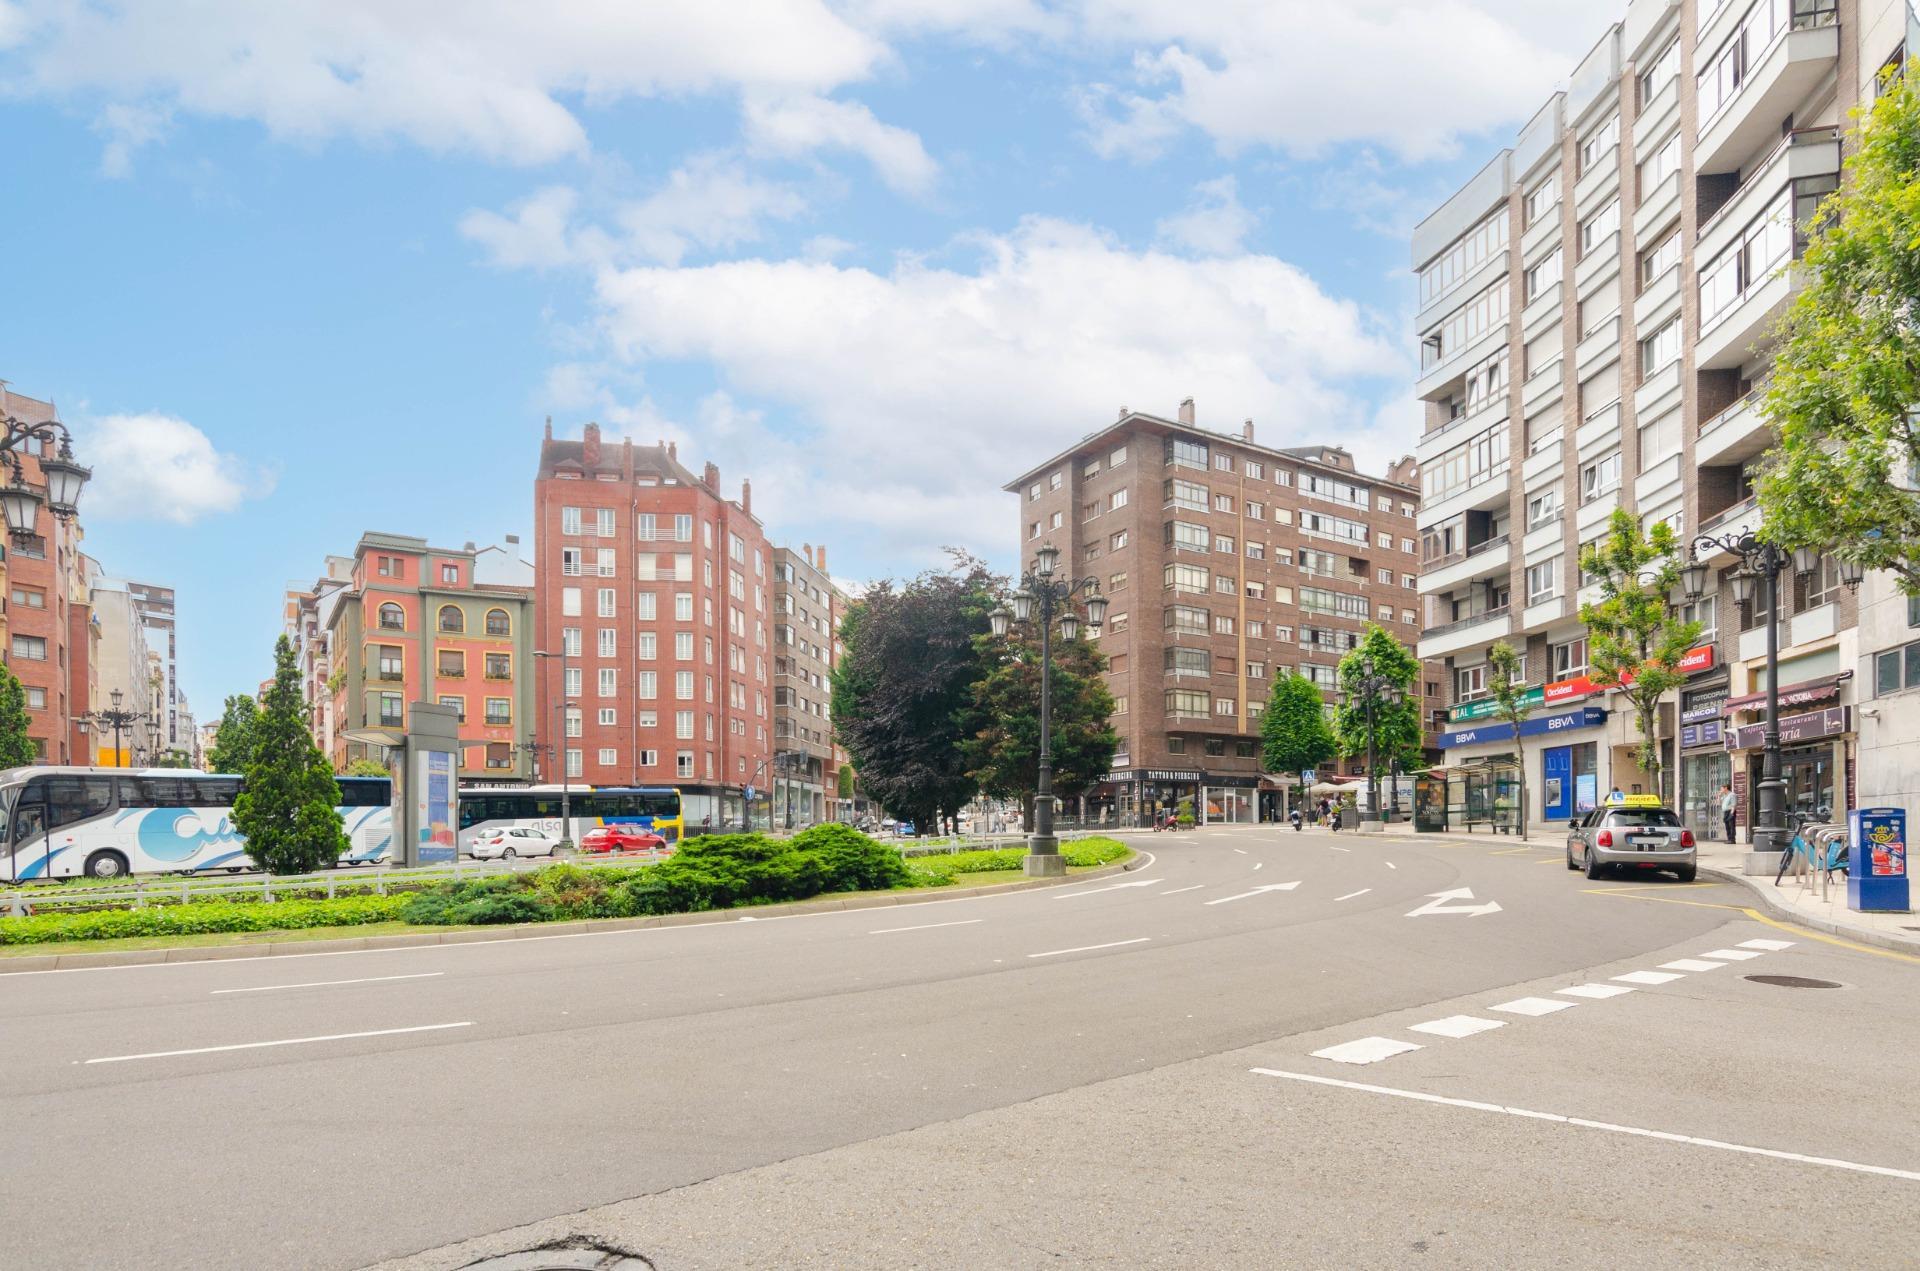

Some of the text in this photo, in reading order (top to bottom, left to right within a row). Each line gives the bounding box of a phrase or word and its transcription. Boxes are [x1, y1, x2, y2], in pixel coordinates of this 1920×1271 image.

[1547, 685, 1572, 696] Occident
[1788, 692, 1812, 702] VICTORIA
[1682, 708, 1716, 719] MARCOS
[1549, 716, 1574, 729] BBVA
[1456, 732, 1475, 743] BBVA
[1148, 771, 1169, 779] TATTOO
[1174, 772, 1200, 780] PIERCING
[531, 820, 561, 831] alsa
